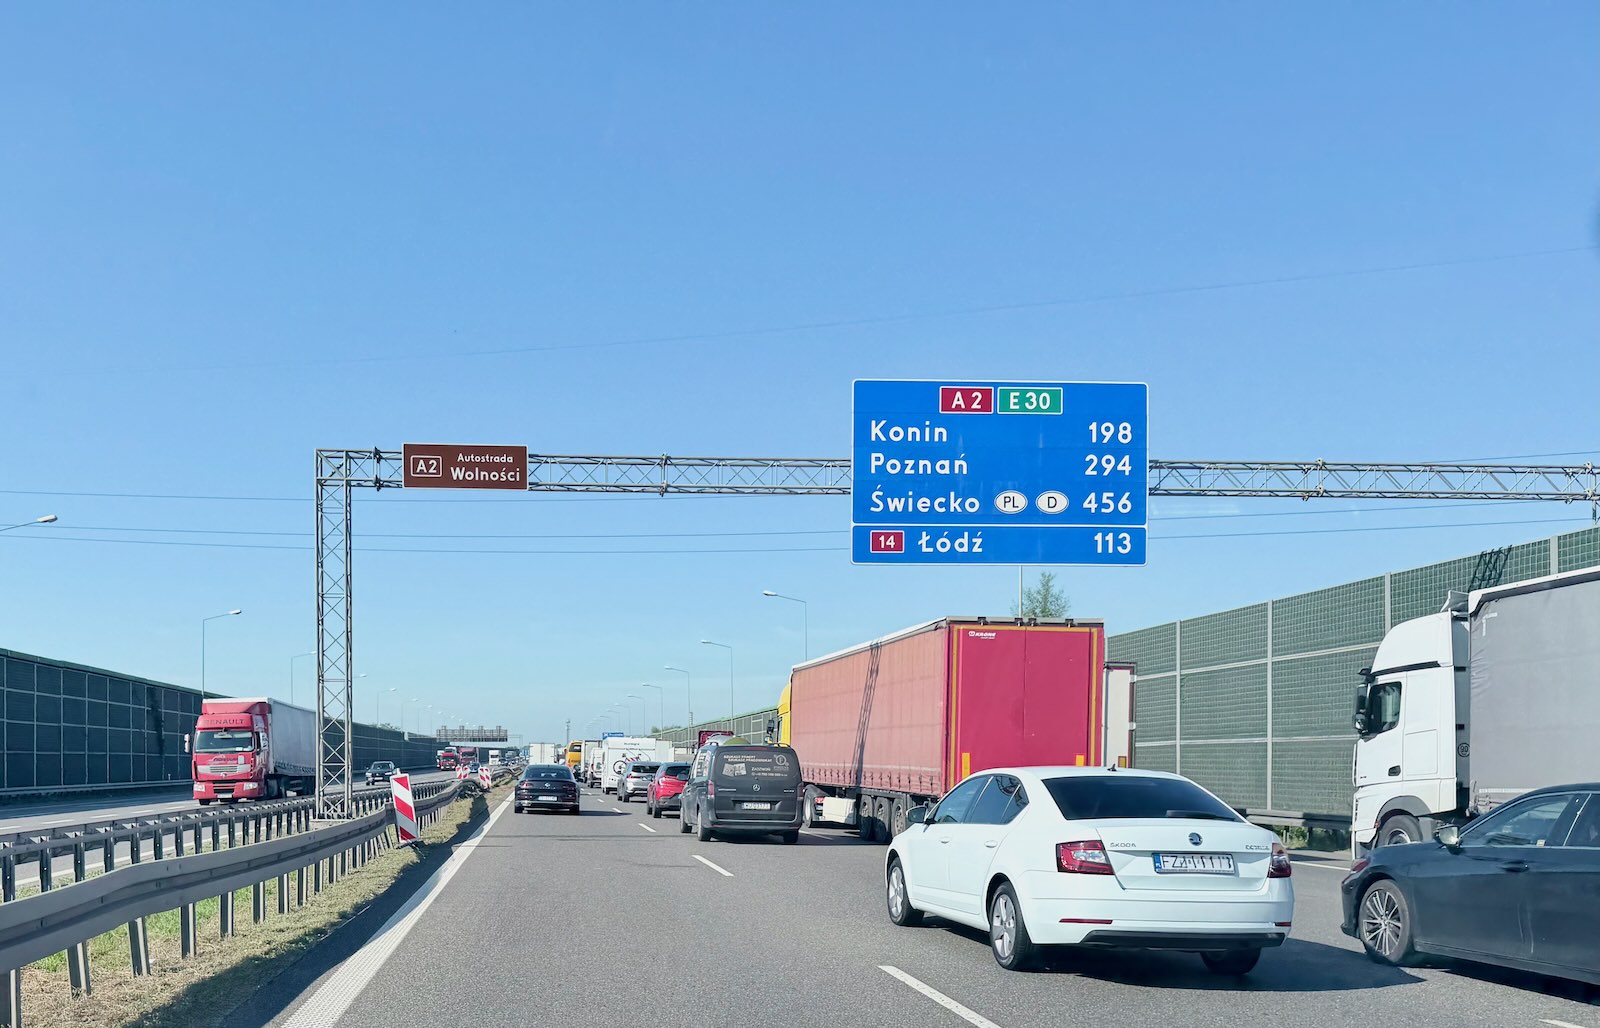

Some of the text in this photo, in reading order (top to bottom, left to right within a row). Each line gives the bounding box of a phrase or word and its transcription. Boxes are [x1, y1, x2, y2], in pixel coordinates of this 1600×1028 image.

[870, 419, 1133, 444] Konin 198
[415, 459, 438, 474] A2
[457, 452, 514, 463] Autostrada
[870, 452, 1132, 476] Poznań 294
[450, 466, 520, 482] Wolności
[869, 484, 1132, 514] Świecko PL D 456
[878, 531, 1132, 554] 14 Łódź 113
